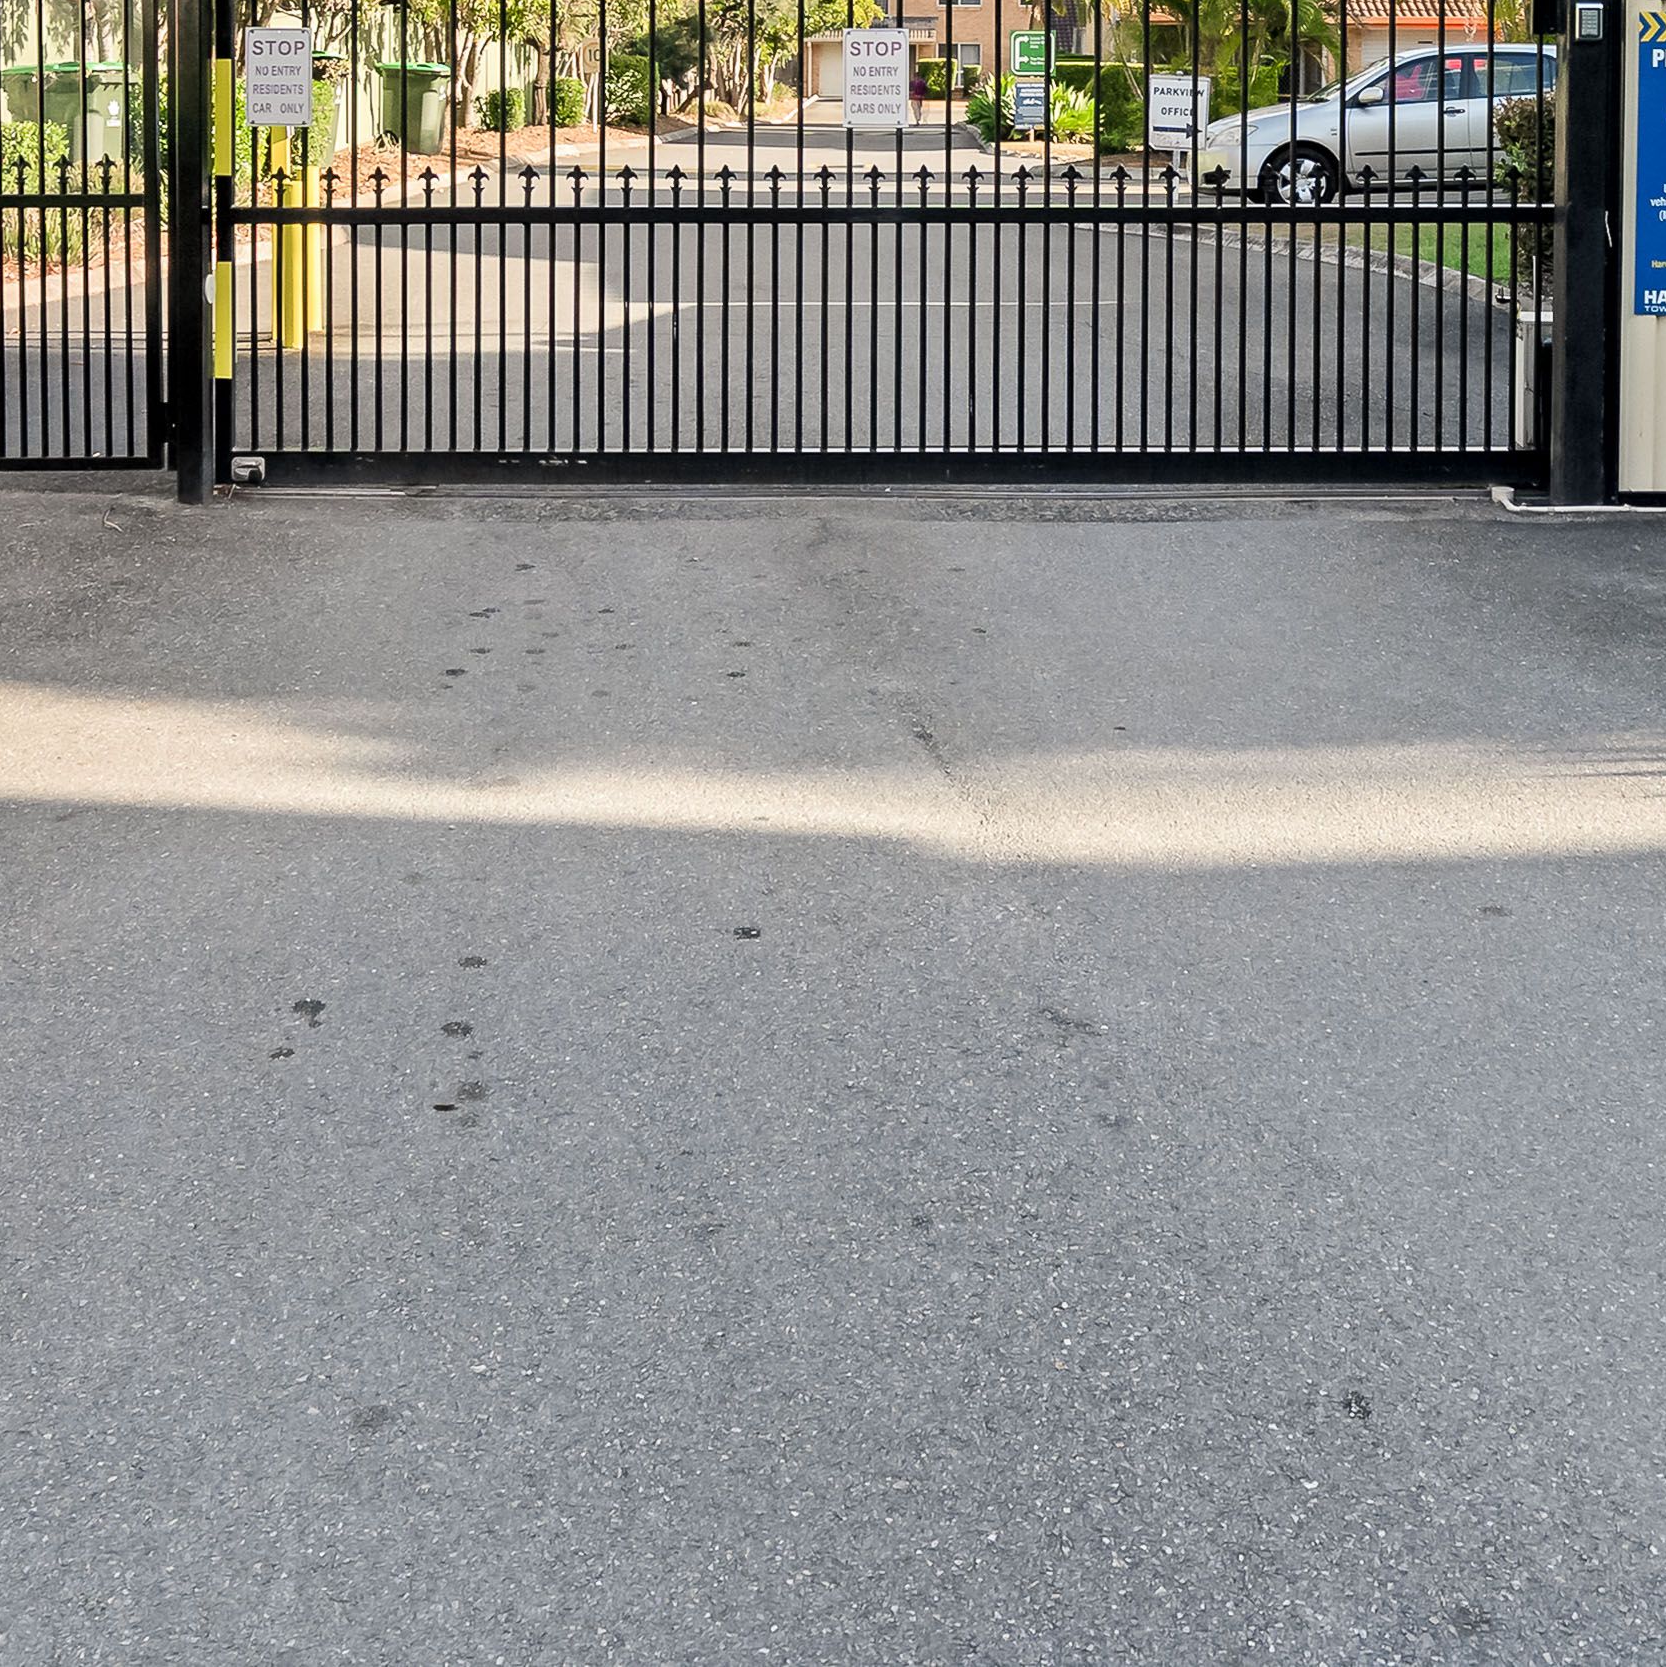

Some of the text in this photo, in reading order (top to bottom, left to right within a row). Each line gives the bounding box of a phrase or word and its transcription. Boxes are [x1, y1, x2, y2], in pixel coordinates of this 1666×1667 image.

[252, 40, 305, 55] STOP
[850, 41, 902, 56] STOP
[255, 65, 302, 76] NO ENTRY
[853, 66, 899, 77] NO ENTRY
[252, 84, 304, 95] RESIDENTS
[850, 85, 901, 95] RESIDENTS
[252, 103, 304, 114] CAR ONLY
[850, 103, 901, 114] CARS ONLY
